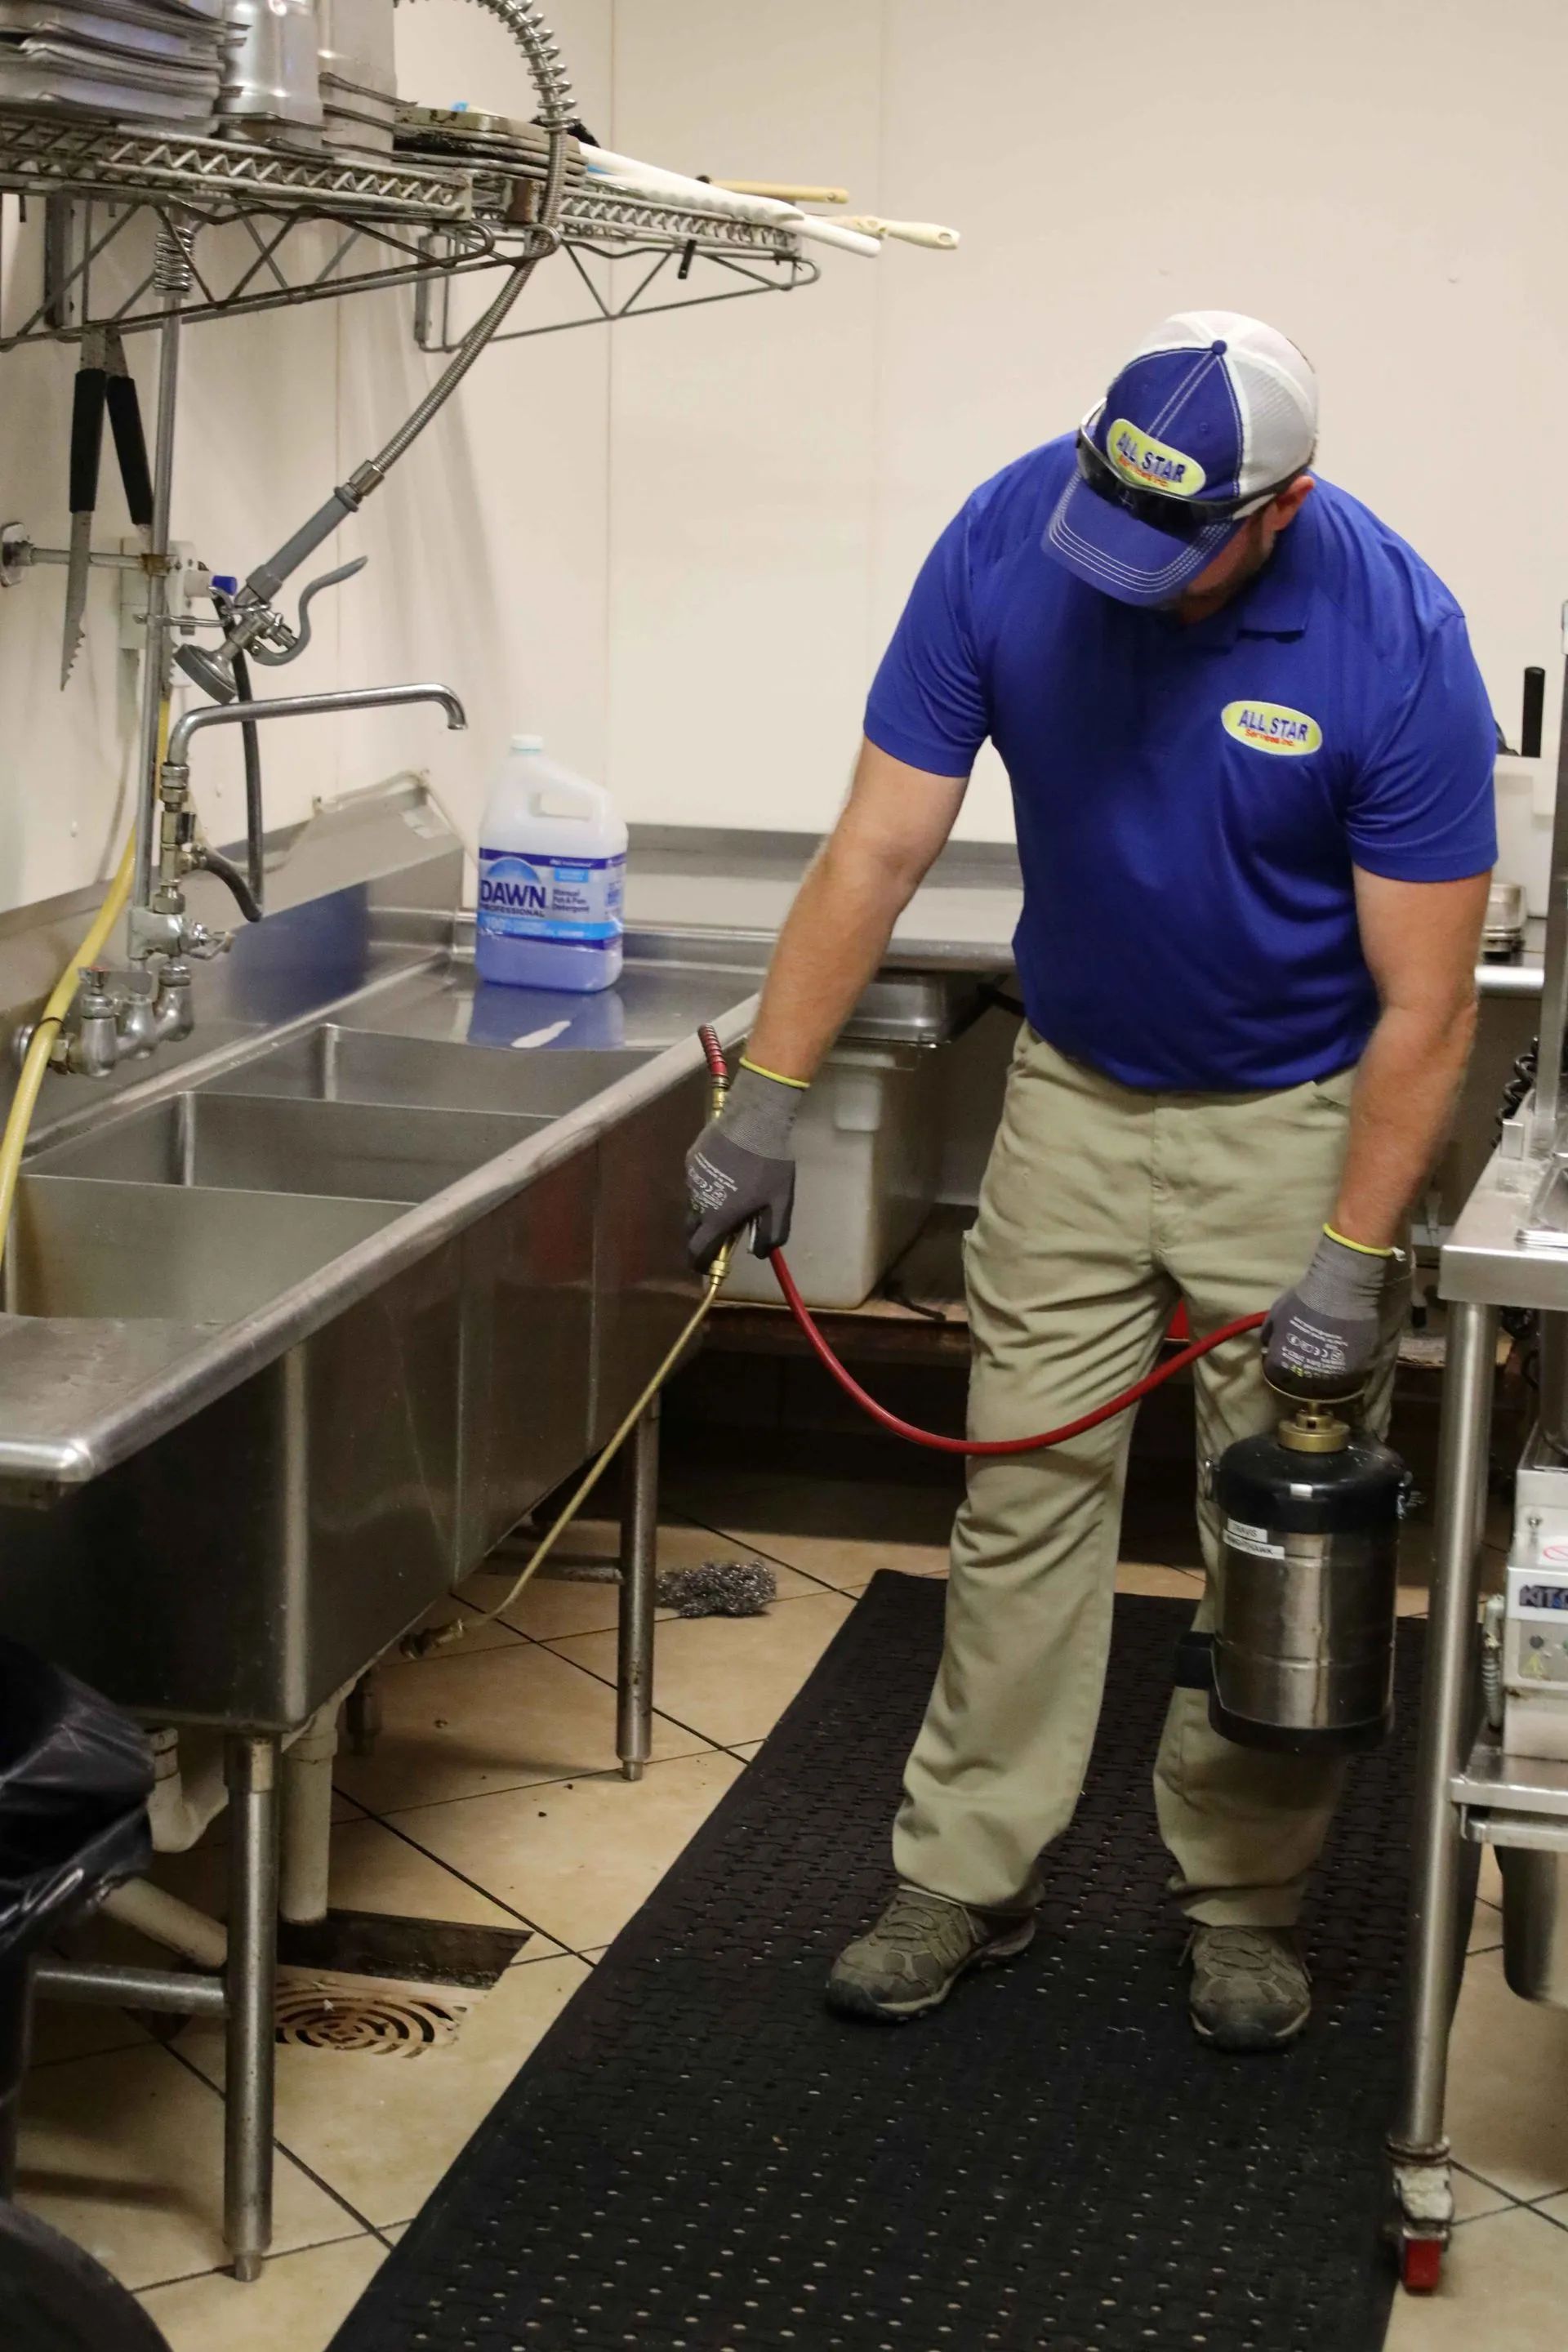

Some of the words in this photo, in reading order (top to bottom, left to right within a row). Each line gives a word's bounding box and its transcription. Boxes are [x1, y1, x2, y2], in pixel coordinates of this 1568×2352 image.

[1116, 430, 1137, 464] ALL
[1142, 451, 1186, 483] STAR
[1237, 709, 1266, 732] ALL
[1269, 717, 1308, 742] STAR
[479, 903, 545, 918] PROFESSIONAL
[480, 879, 546, 910] DAWN
